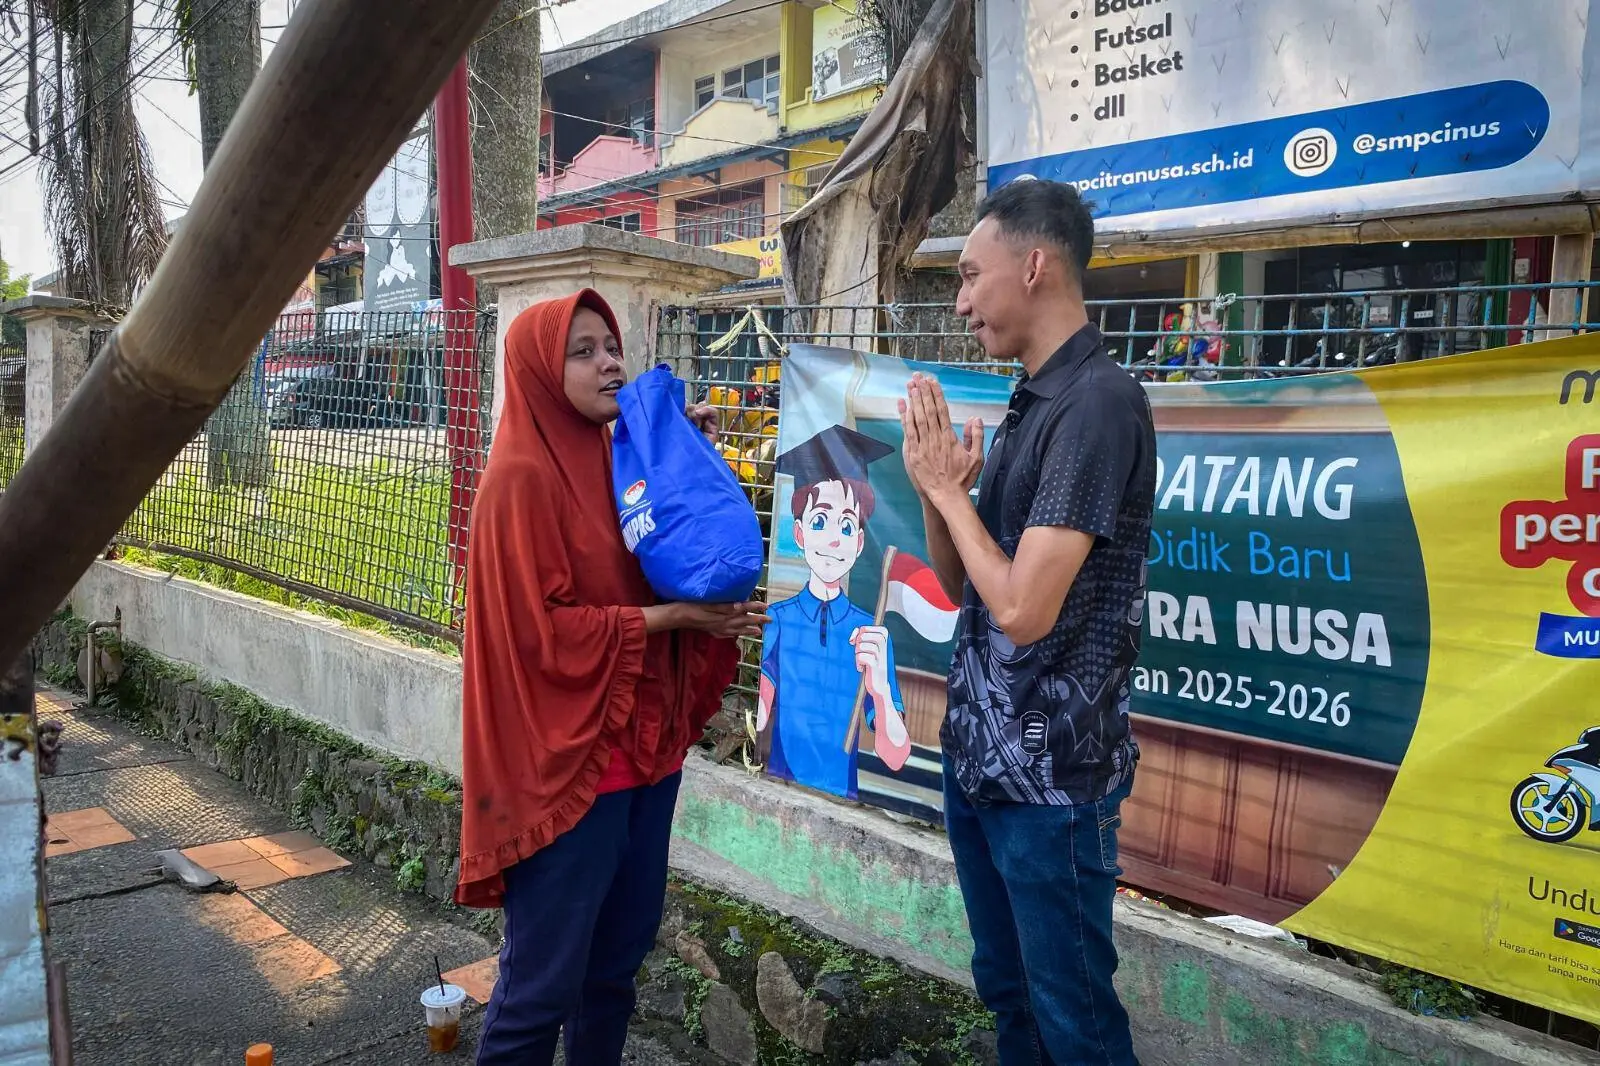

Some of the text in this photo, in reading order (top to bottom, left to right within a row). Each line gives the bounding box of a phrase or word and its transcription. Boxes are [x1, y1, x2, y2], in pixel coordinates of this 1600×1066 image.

[1094, 12, 1172, 52] Futsal
[1094, 50, 1184, 87] Basket
[1093, 93, 1125, 121] dll
[1352, 121, 1501, 154] @smpcinus
[1249, 530, 1352, 583] Baru
[1144, 590, 1393, 668] RA NUSA
[1130, 664, 1351, 728] an 2025-2026
[1499, 938, 1527, 955] Harga
[1528, 947, 1546, 959] dan
[1548, 952, 1568, 966] tarif
[1570, 958, 1589, 971] bisa
